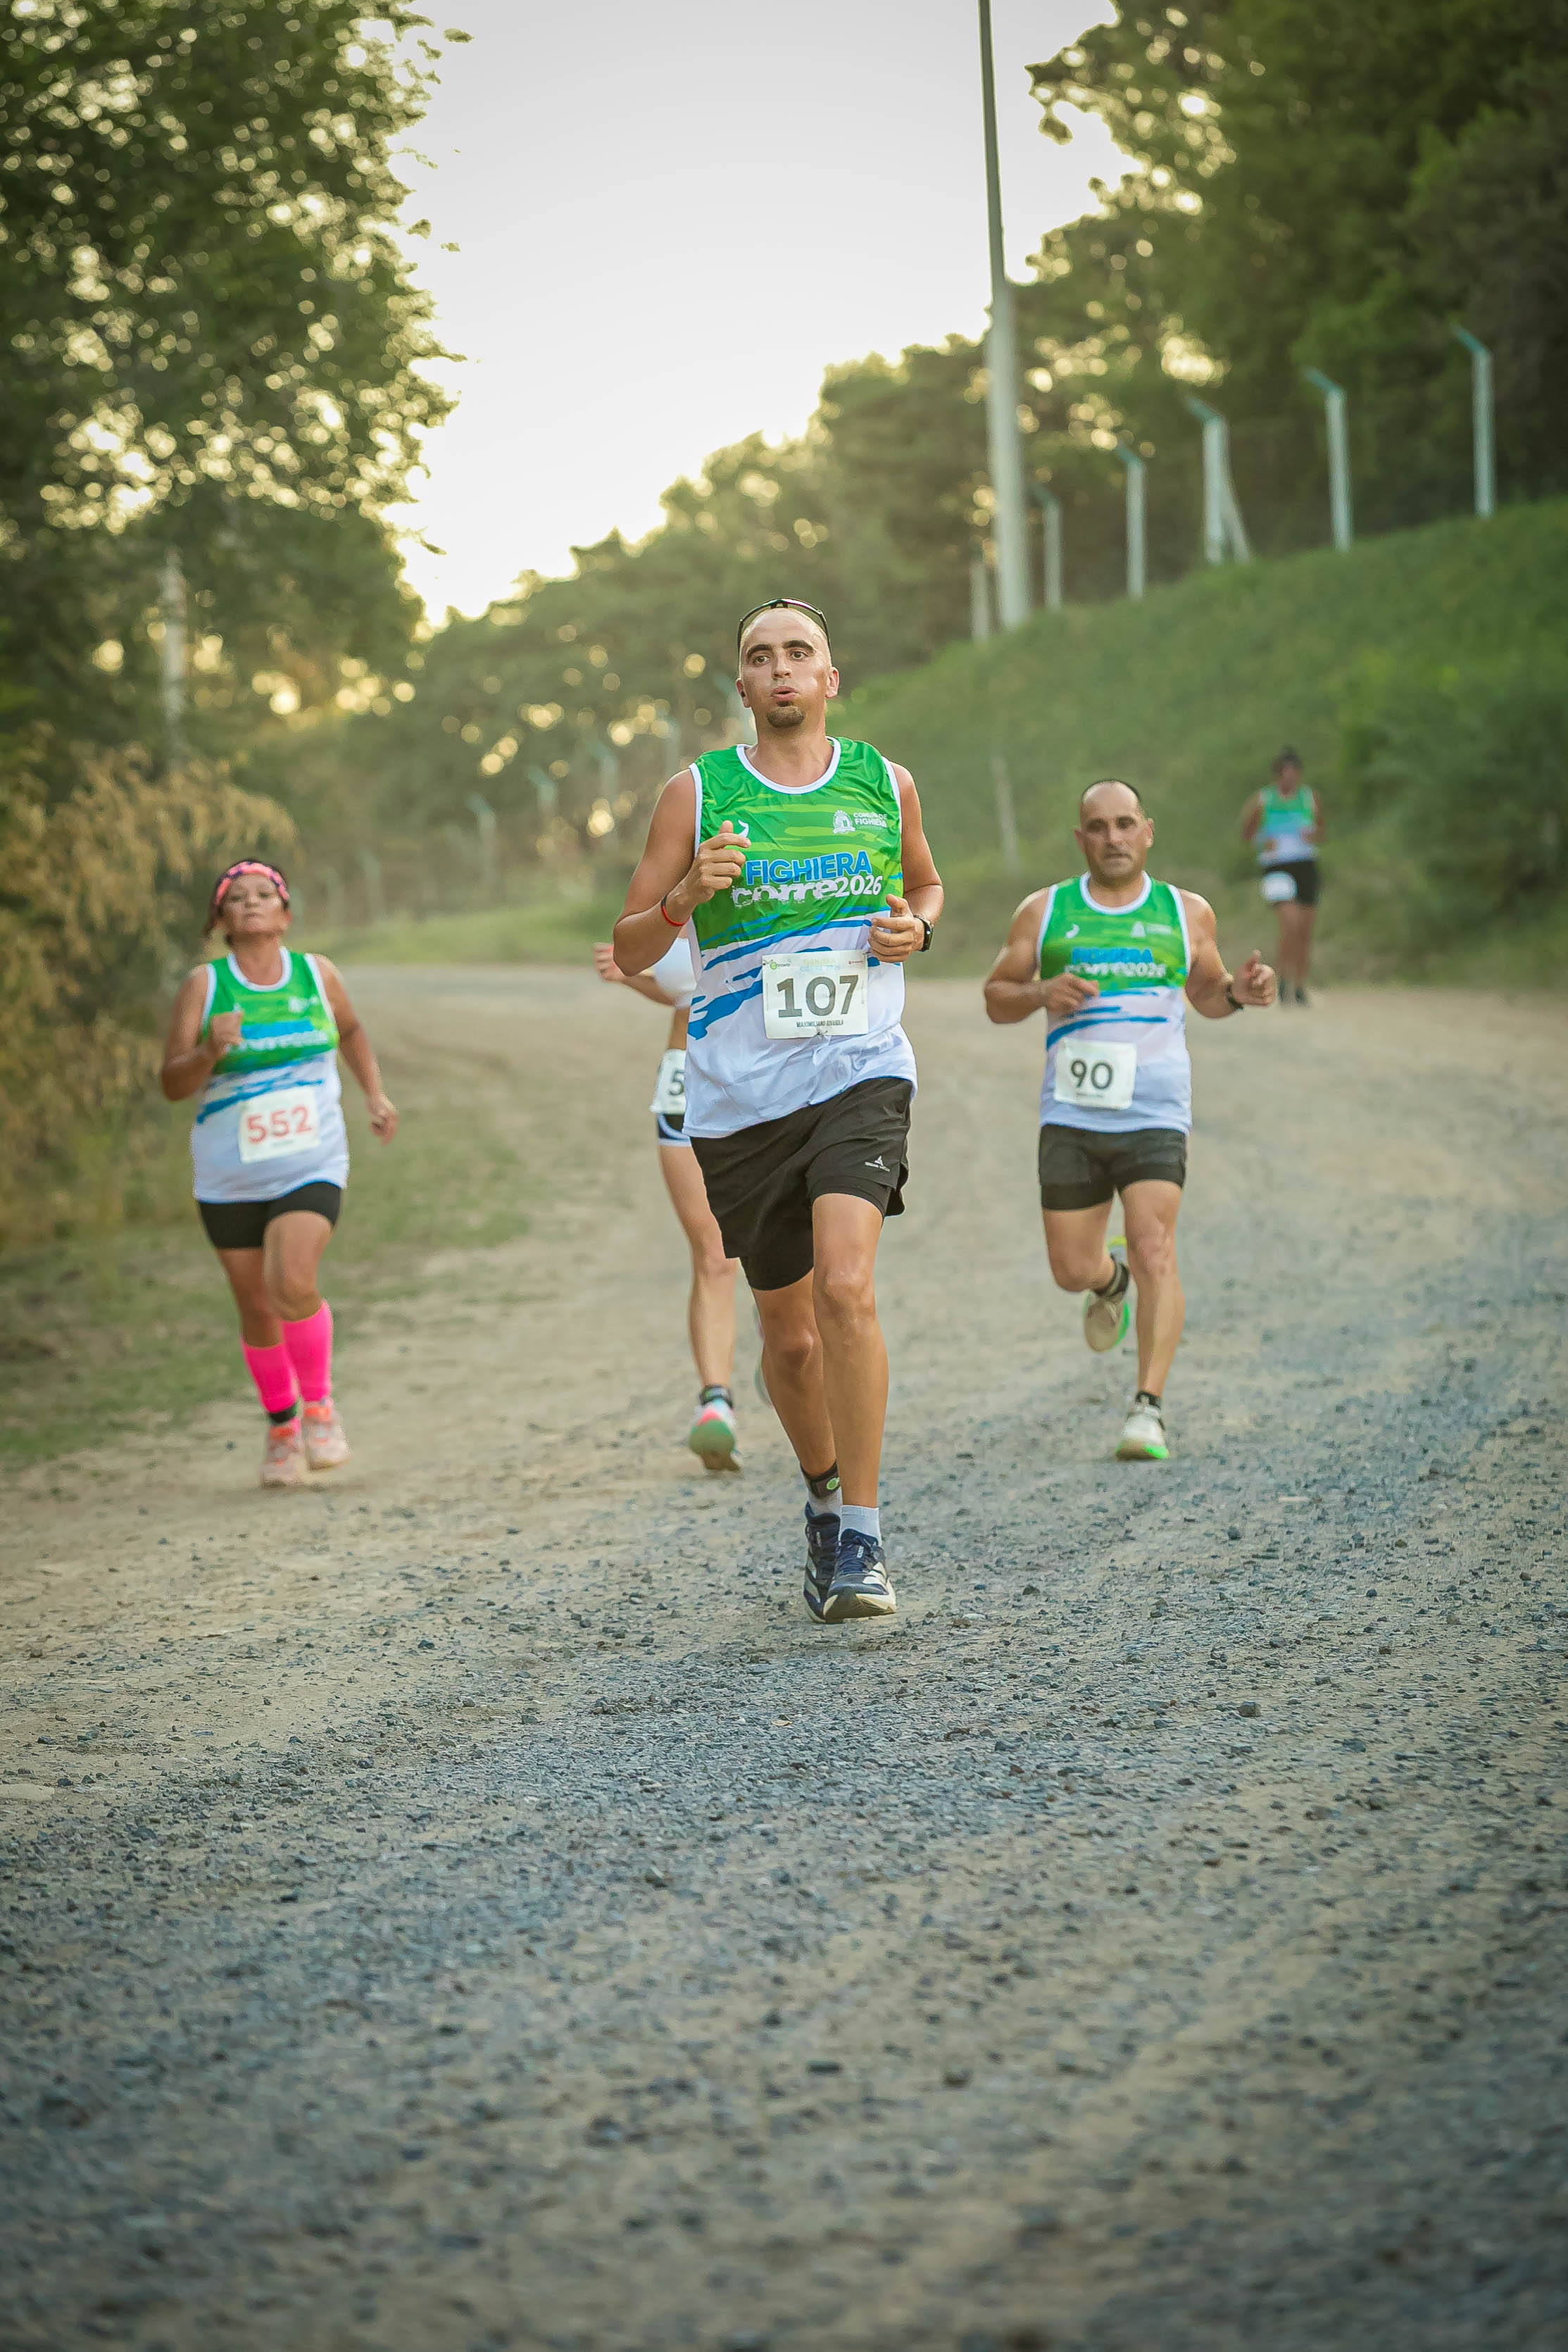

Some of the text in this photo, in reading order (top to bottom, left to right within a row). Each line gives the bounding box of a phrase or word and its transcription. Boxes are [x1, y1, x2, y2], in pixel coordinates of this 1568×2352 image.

[746, 851, 872, 885] FIGHIERA
[777, 975, 858, 1018] 107
[1070, 1058, 1113, 1089] 90
[247, 1106, 312, 1144] 552
